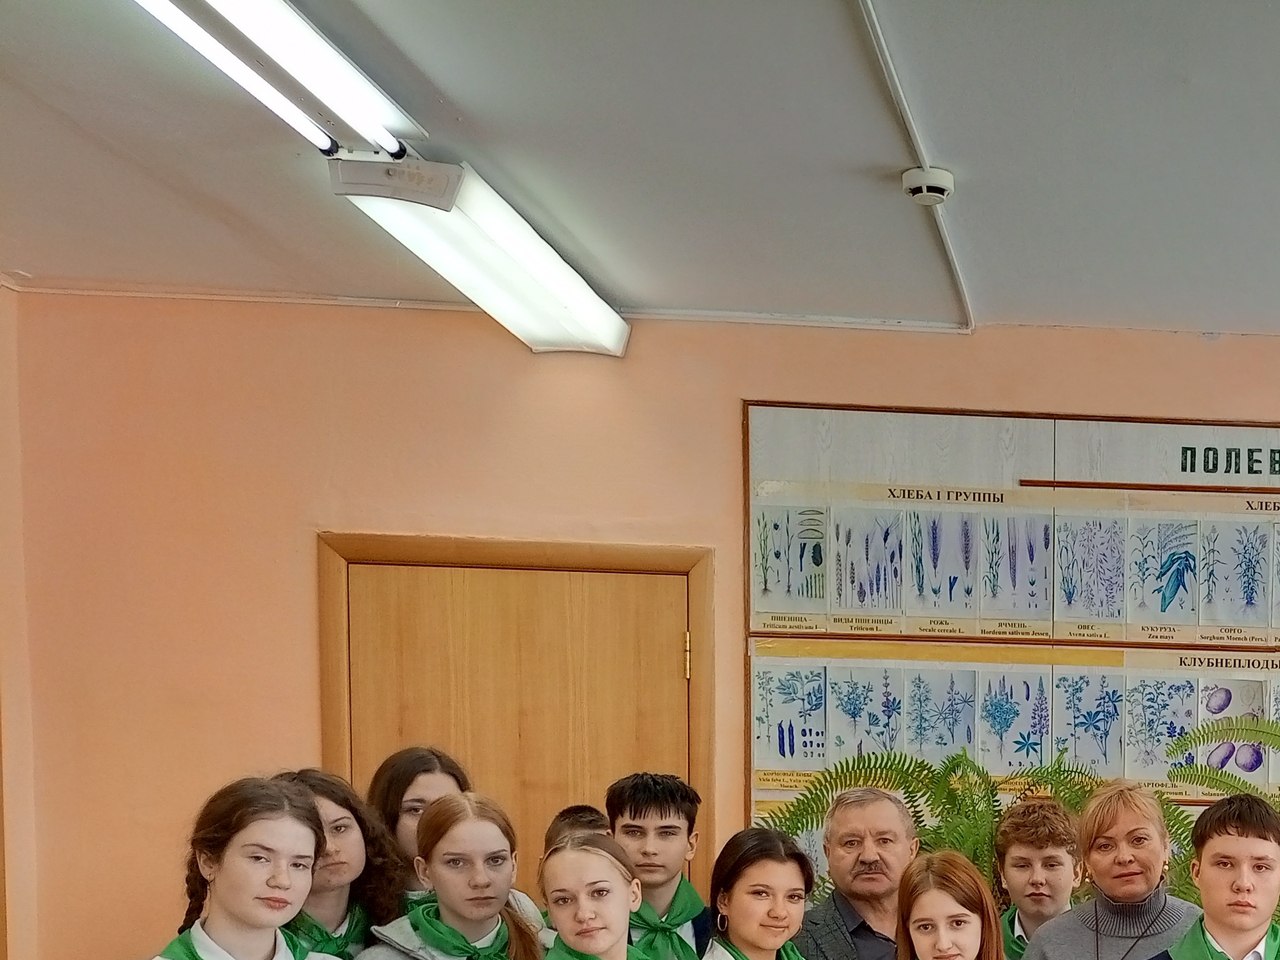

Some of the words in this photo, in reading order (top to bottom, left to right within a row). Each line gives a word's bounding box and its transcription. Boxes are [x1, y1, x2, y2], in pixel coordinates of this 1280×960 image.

[887, 488, 933, 500] ХЛЕБА
[936, 490, 941, 501] I
[946, 490, 1004, 504] ГРУППЫ
[771, 615, 808, 623] ПШЕНИЦА
[833, 617, 854, 625] ВИДЫ
[929, 619, 949, 627] РОЖЬ
[763, 622, 786, 630] Triticum
[850, 625, 874, 633] Triticum
[998, 622, 1027, 630] ЯЧМЕНЬ
[1077, 623, 1096, 631] ОВЕС
[1141, 625, 1176, 633] КУКУРУЗА
[981, 629, 1007, 637] Hordeum
[1200, 634, 1225, 642] Sorghum
